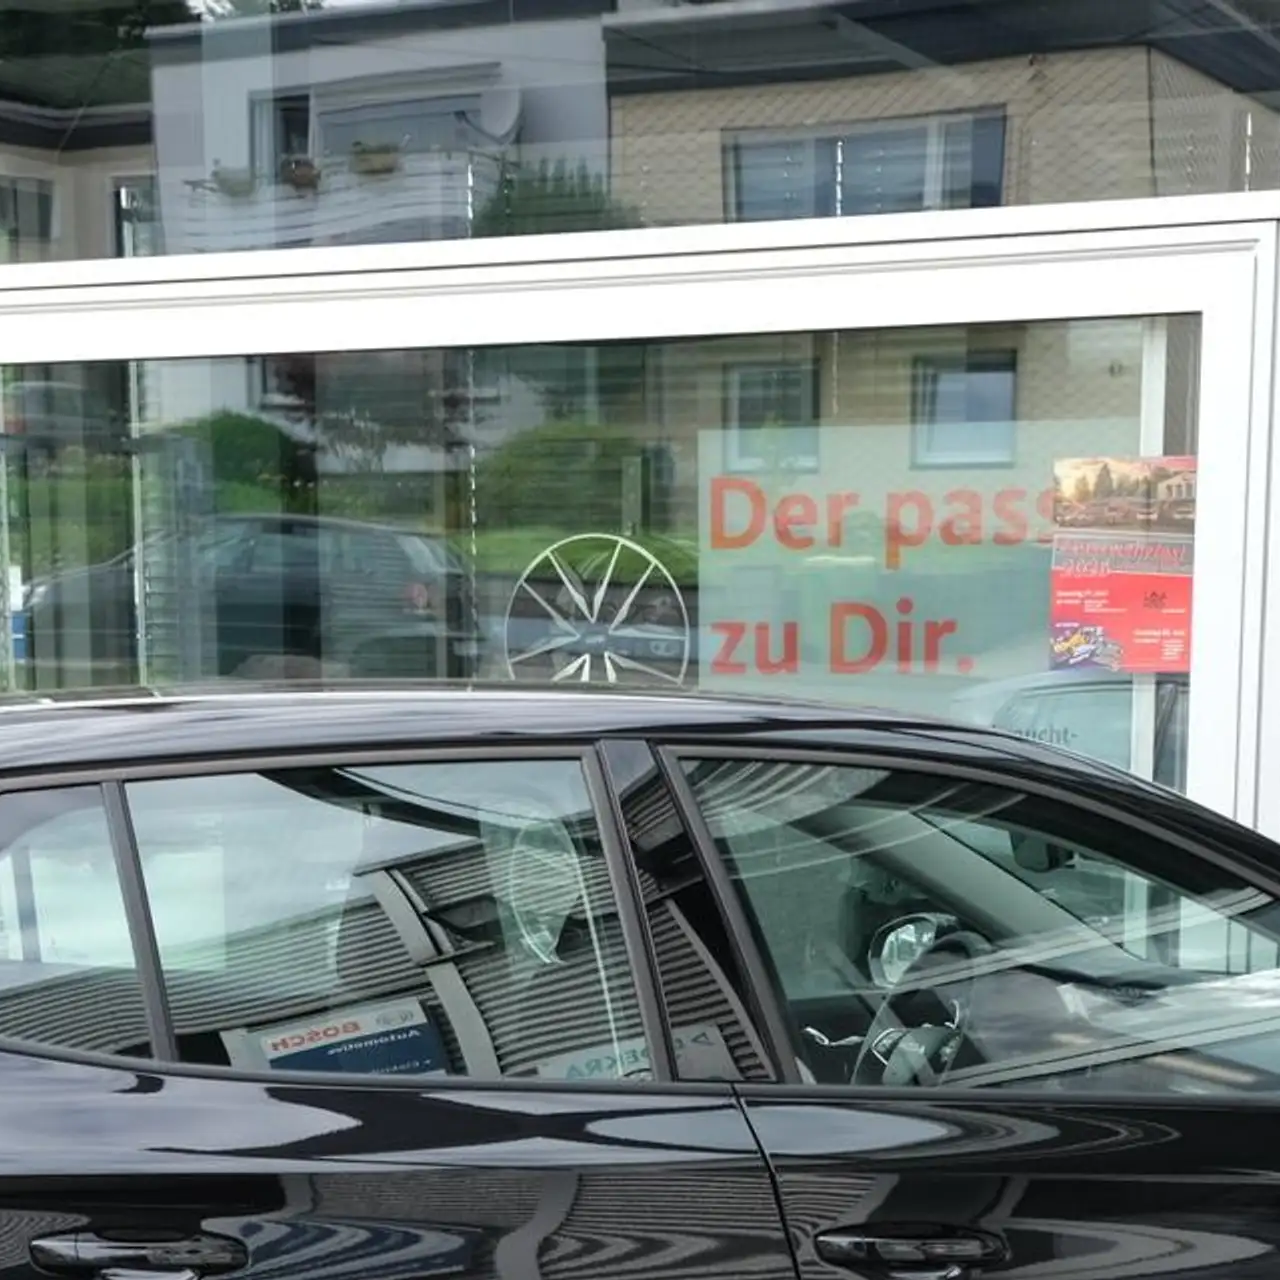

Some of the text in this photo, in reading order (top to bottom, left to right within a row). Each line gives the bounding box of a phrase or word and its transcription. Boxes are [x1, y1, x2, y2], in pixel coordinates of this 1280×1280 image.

[710, 476, 860, 549] Der
[710, 597, 975, 675] zu Dir.
